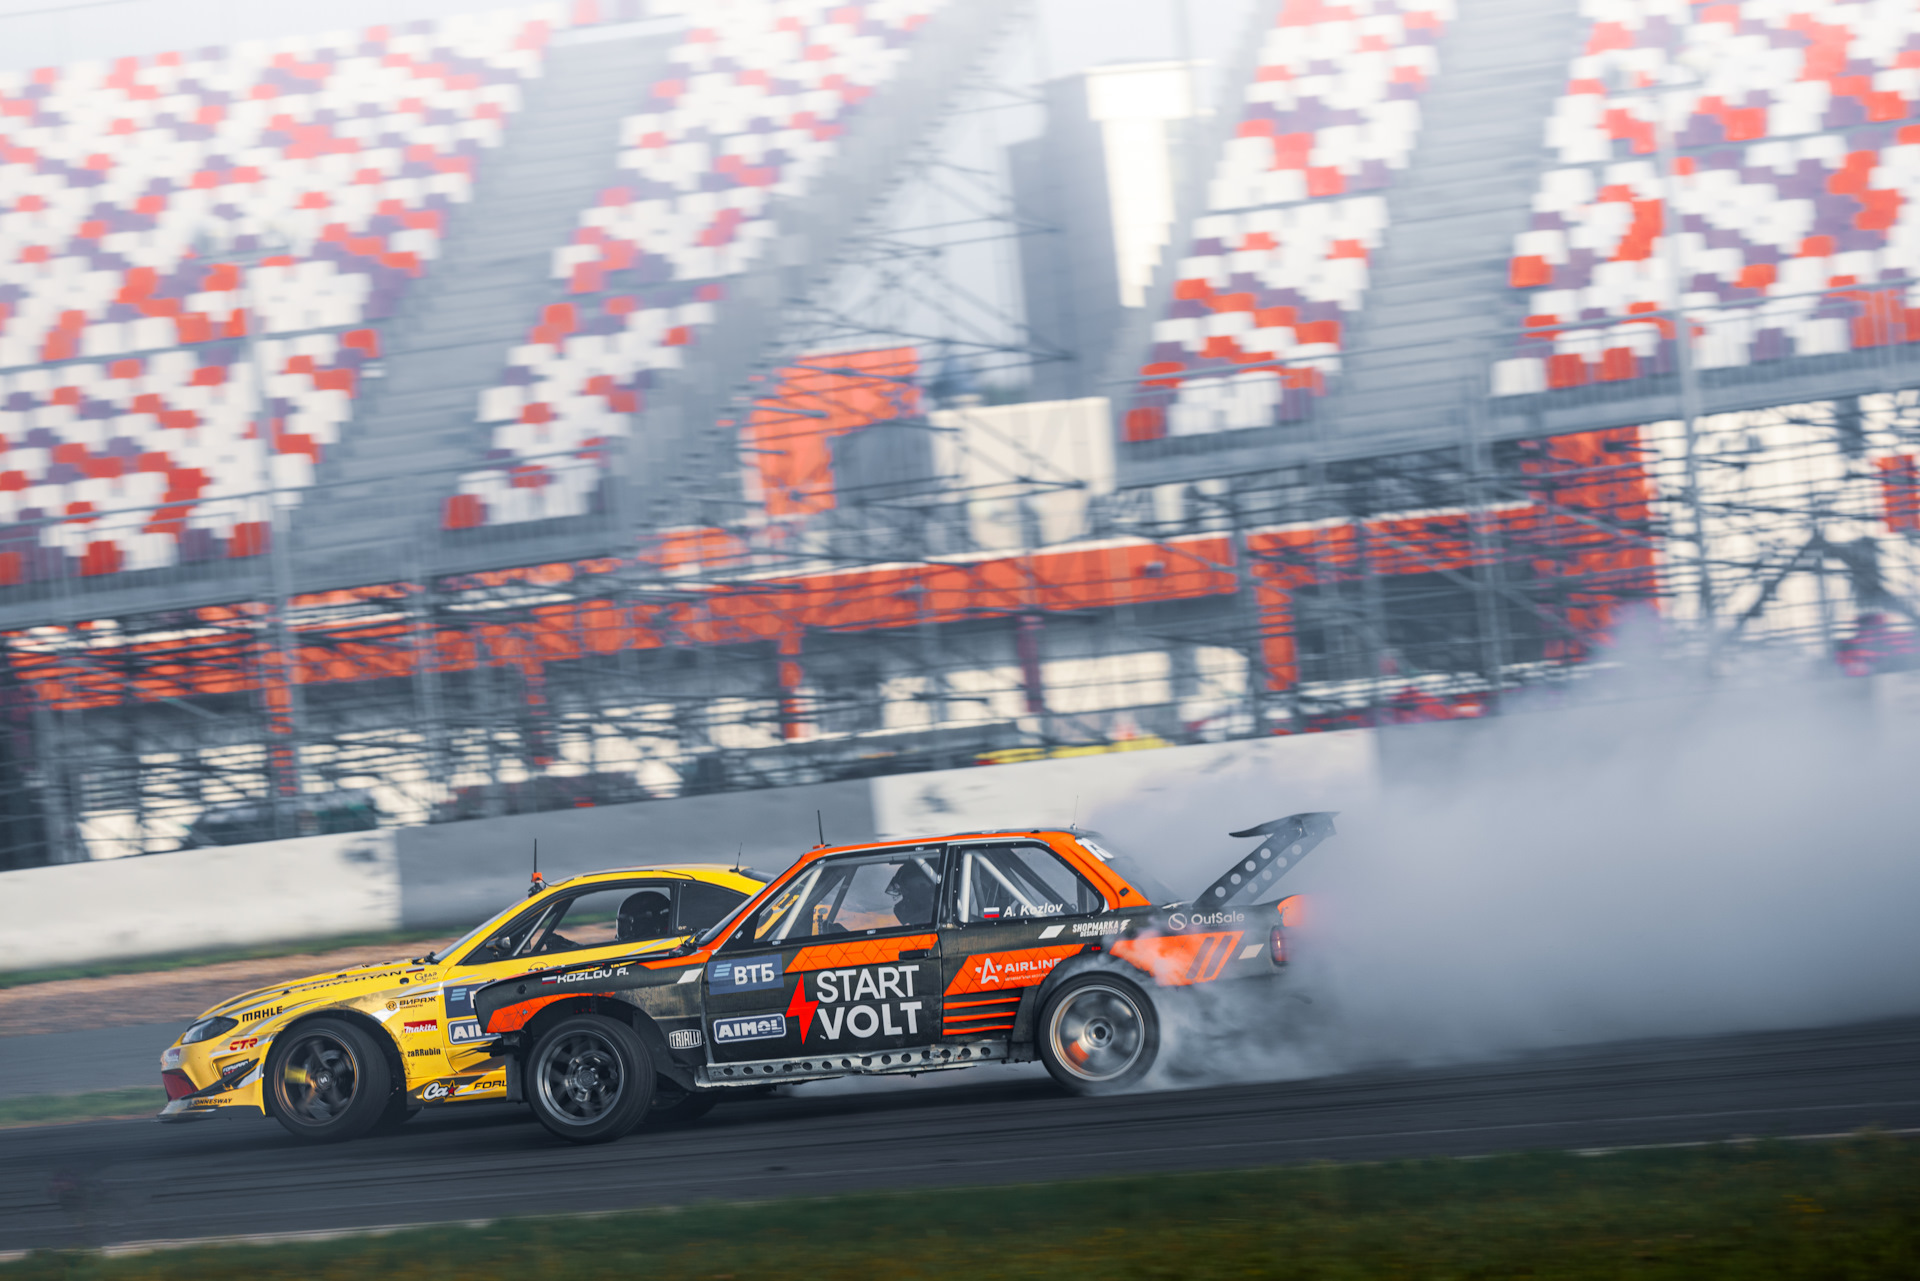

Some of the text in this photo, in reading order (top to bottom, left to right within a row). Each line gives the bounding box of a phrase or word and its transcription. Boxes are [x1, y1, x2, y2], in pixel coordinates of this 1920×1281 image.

[1003, 903, 1063, 918] A. Kozlov
[1191, 911, 1246, 926] OutSale
[1072, 920, 1119, 933] SHOPMARKA
[557, 968, 613, 984] KOZLOV
[616, 967, 630, 977] A.
[733, 963, 775, 985] ВТБ
[816, 965, 920, 1003] START
[242, 1005, 283, 1022] MAHLE
[816, 1001, 922, 1040] VOLT
[718, 1018, 783, 1038] AIMOL
[229, 1037, 259, 1051] CTR
[670, 1031, 701, 1048] TRIALLI
